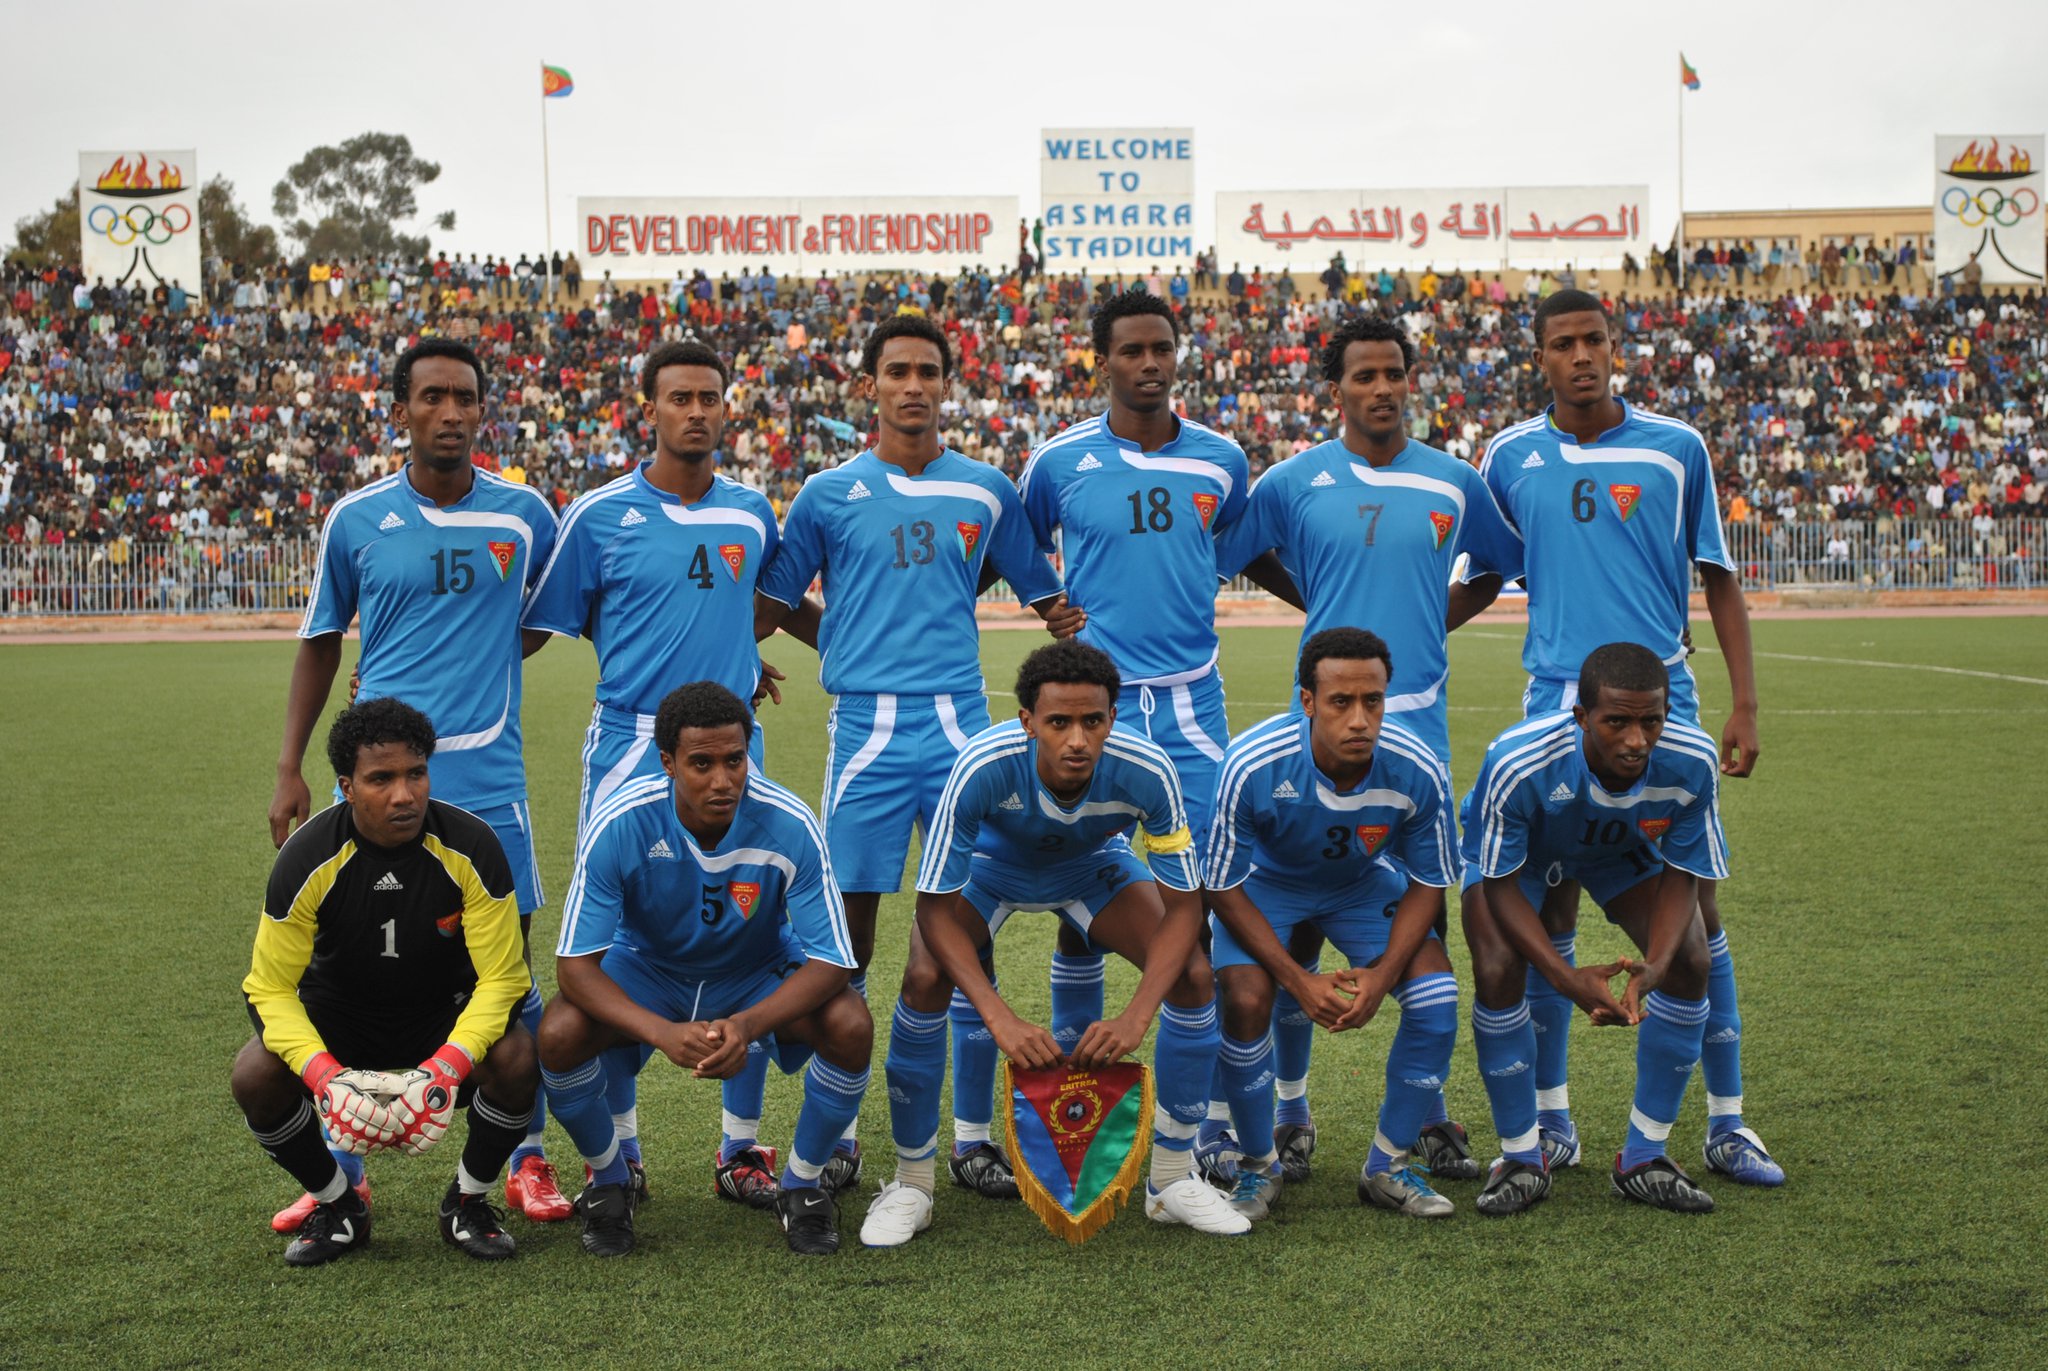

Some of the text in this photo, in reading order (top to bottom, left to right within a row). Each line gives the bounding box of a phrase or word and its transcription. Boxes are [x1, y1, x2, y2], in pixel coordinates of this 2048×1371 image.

[1045, 138, 1191, 160] WELCOME
[1098, 171, 1140, 192] TO
[1046, 203, 1191, 227] ASMARA
[587, 214, 800, 255] DEVELOPMENT
[1046, 236, 1192, 260] STADIUM
[1075, 459, 1103, 472] adidas
[1310, 478, 1336, 487] adidas
[847, 489, 871, 501] adidas
[1571, 478, 1597, 523] 6
[620, 515, 647, 527] adidas
[1127, 487, 1173, 534] 18
[379, 518, 405, 530] adidas
[1358, 503, 1384, 547] 7
[890, 520, 935, 569] 13
[430, 548, 476, 596] 15
[687, 544, 714, 589] 4
[998, 802, 1024, 811] adidas
[1272, 791, 1300, 799] adidas
[1549, 792, 1576, 802] adidas
[1039, 835, 1064, 852] 2
[1322, 826, 1350, 860] 3
[1578, 818, 1628, 846] 10
[648, 850, 674, 859] adidas
[373, 882, 404, 891] adidas
[1097, 863, 1131, 892] 2
[701, 883, 724, 926] 5
[380, 918, 400, 959] 1
[1060, 1079, 1099, 1091] ERITREA
